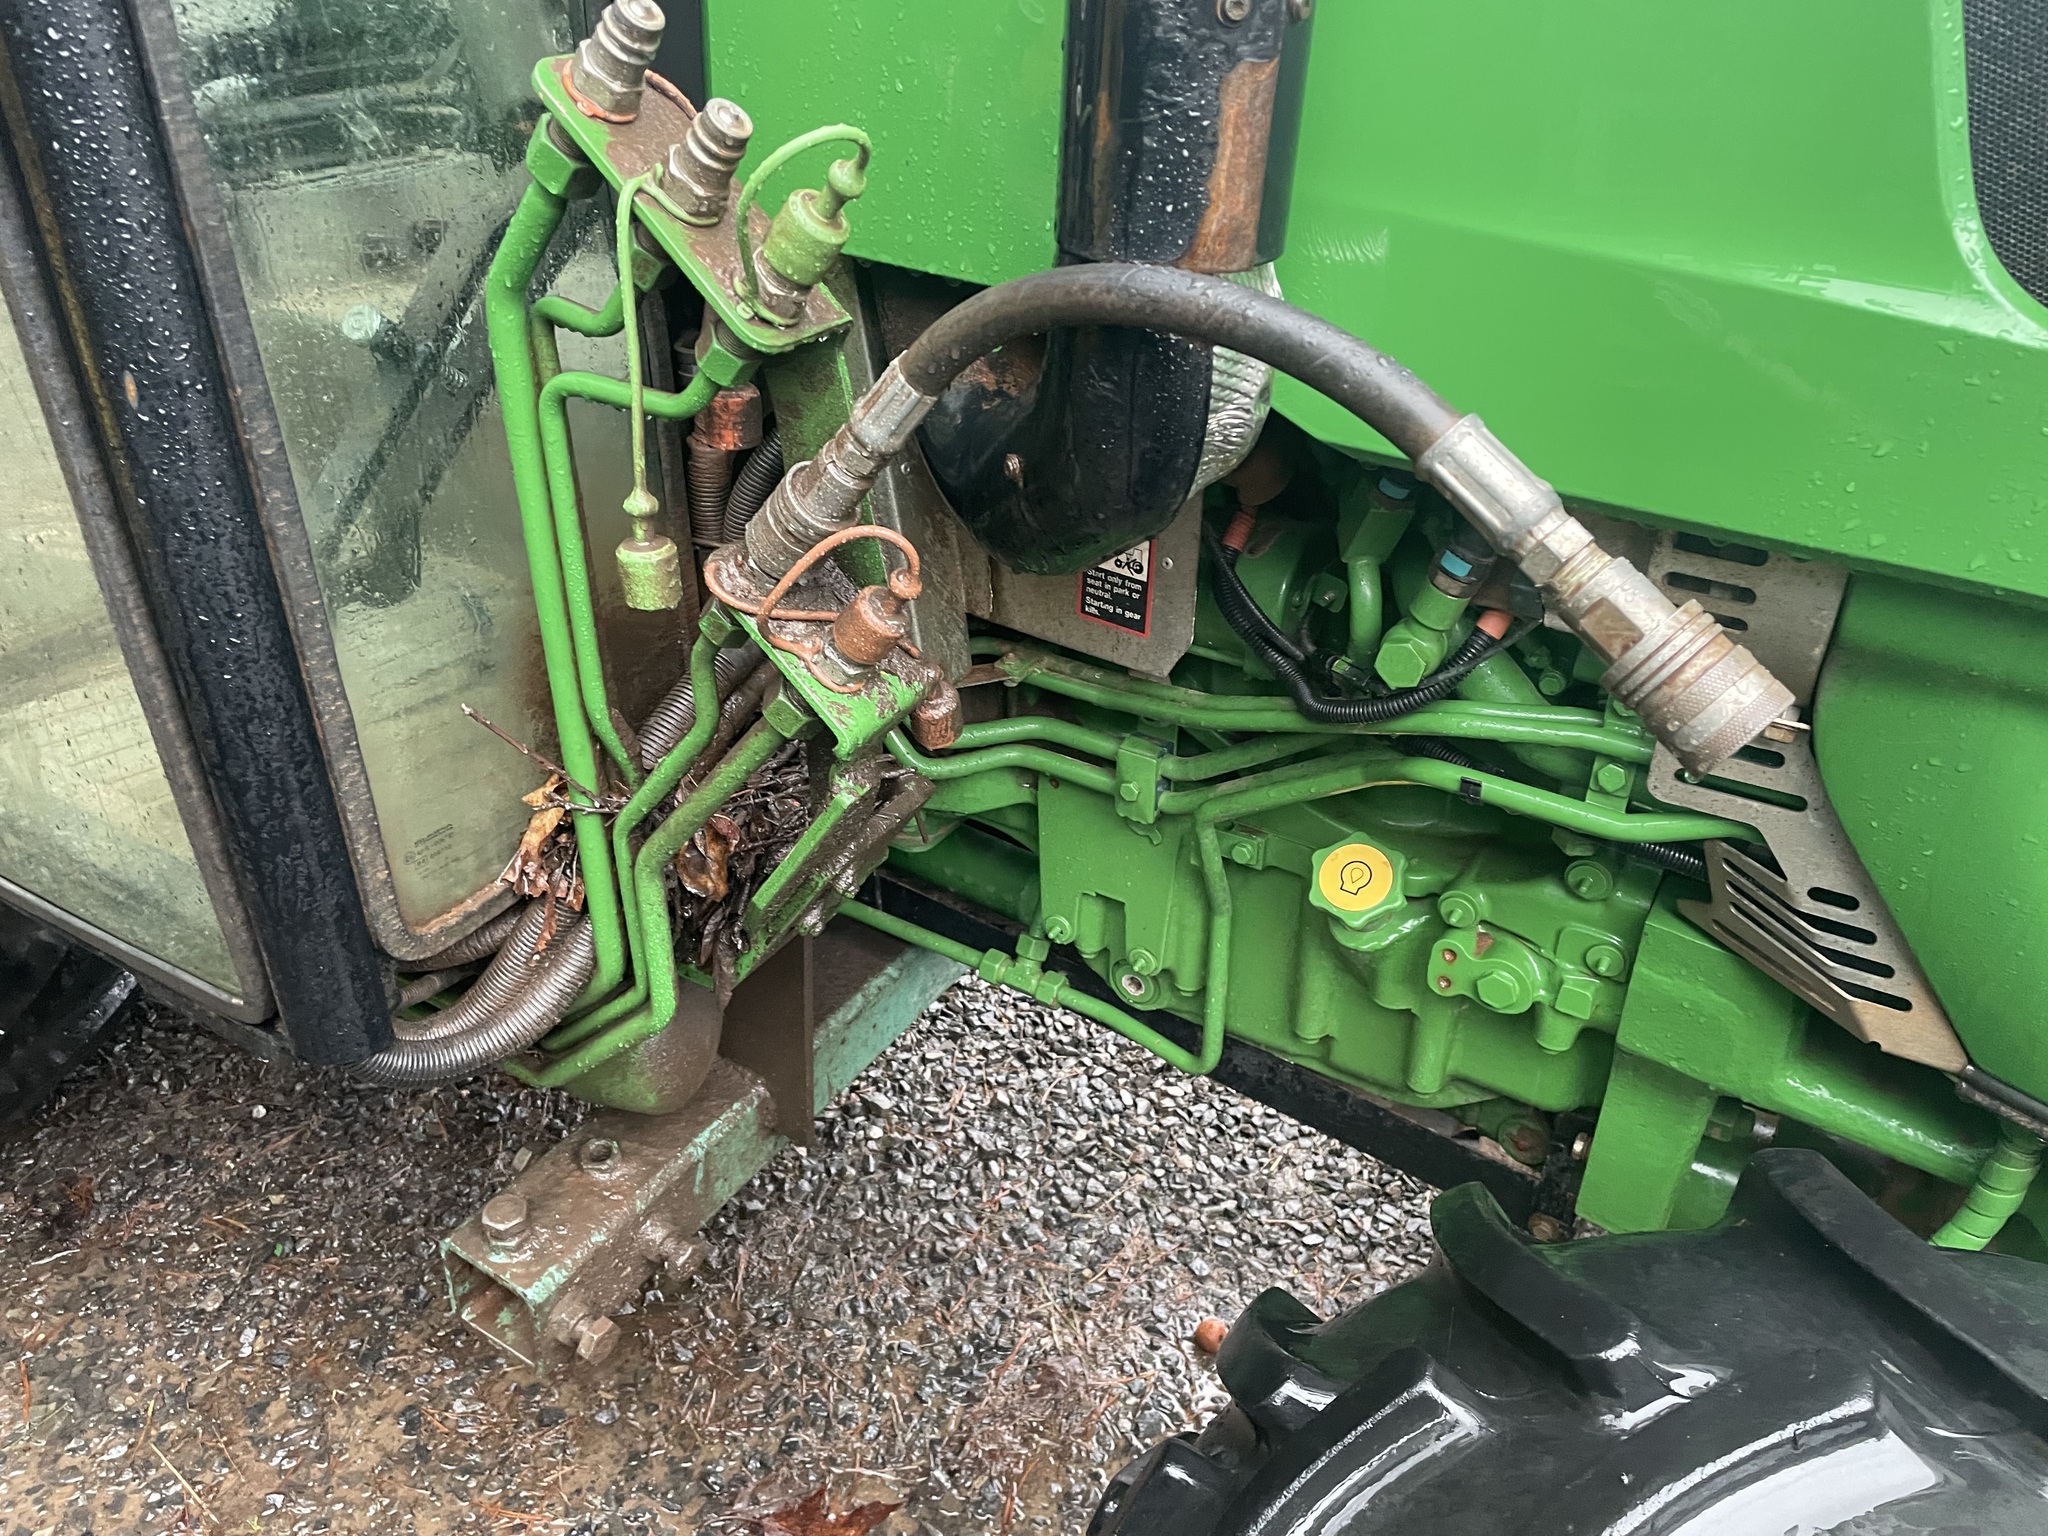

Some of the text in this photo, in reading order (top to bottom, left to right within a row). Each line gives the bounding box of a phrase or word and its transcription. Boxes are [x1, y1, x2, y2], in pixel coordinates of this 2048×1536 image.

[1086, 577, 1140, 600] seat in park or
[1087, 569, 1142, 591] Start only from
[1086, 586, 1113, 600] neutral.
[1085, 596, 1141, 621] Starting in gear
[1085, 604, 1100, 616] kills.
